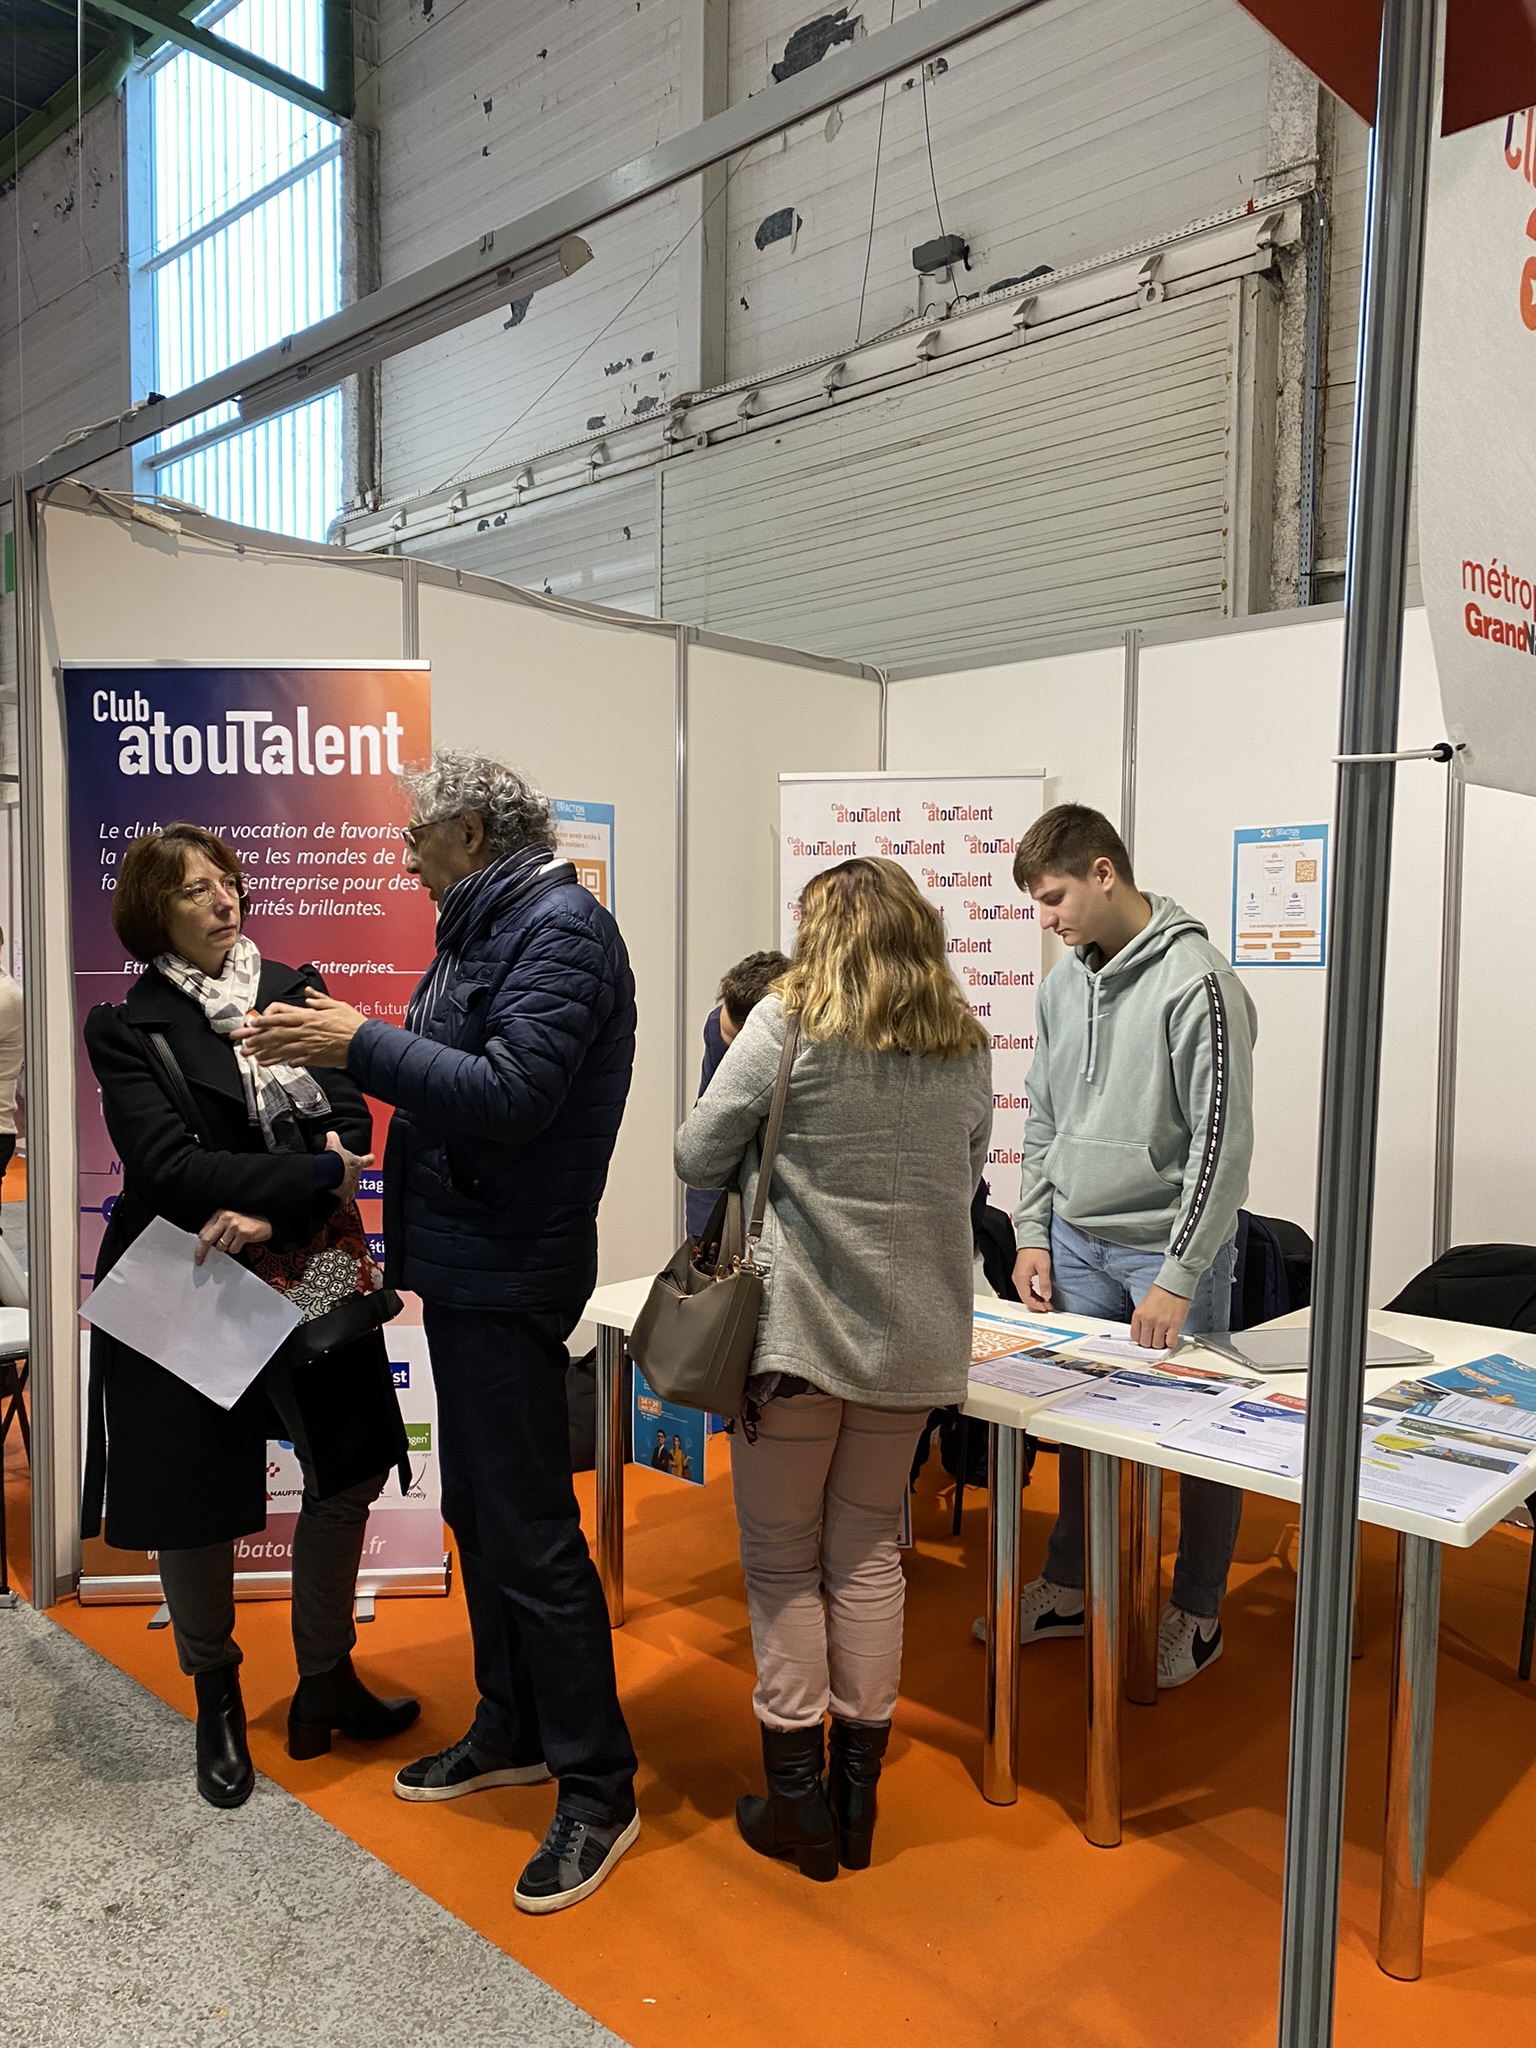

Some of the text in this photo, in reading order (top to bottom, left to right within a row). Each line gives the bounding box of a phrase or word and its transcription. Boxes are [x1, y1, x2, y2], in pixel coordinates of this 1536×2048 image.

[1464, 602, 1536, 656] GrandN
[92, 690, 150, 722] Club
[118, 706, 405, 776] atouTalent
[831, 803, 844, 811] Club
[922, 802, 936, 810] Club
[928, 805, 993, 821] atouTalent
[837, 807, 901, 822] atouTalent
[99, 823, 119, 839] Le
[231, 822, 307, 839] vocation
[313, 821, 335, 839] de
[964, 834, 978, 842] Club
[793, 840, 857, 856] atouTalent
[875, 836, 889, 844] Club
[881, 839, 945, 855] atouTalent
[970, 838, 1021, 854] atouTale
[100, 848, 116, 864] la
[235, 848, 259, 864] tre
[265, 847, 291, 864] les
[297, 847, 367, 864] mondes
[372, 848, 396, 864] de
[921, 868, 935, 876] Club
[927, 871, 993, 888] atouTalent
[248, 873, 420, 894] entreprise pour des
[298, 898, 386, 916] brillantes.
[963, 900, 977, 908] Club
[969, 904, 1034, 920] atouTalent
[947, 937, 992, 953] uTalent
[963, 966, 977, 974] Club
[968, 970, 1034, 986] atouTalent
[354, 1000, 409, 1015] de futur
[270, 1489, 303, 1497] MAUFFR
